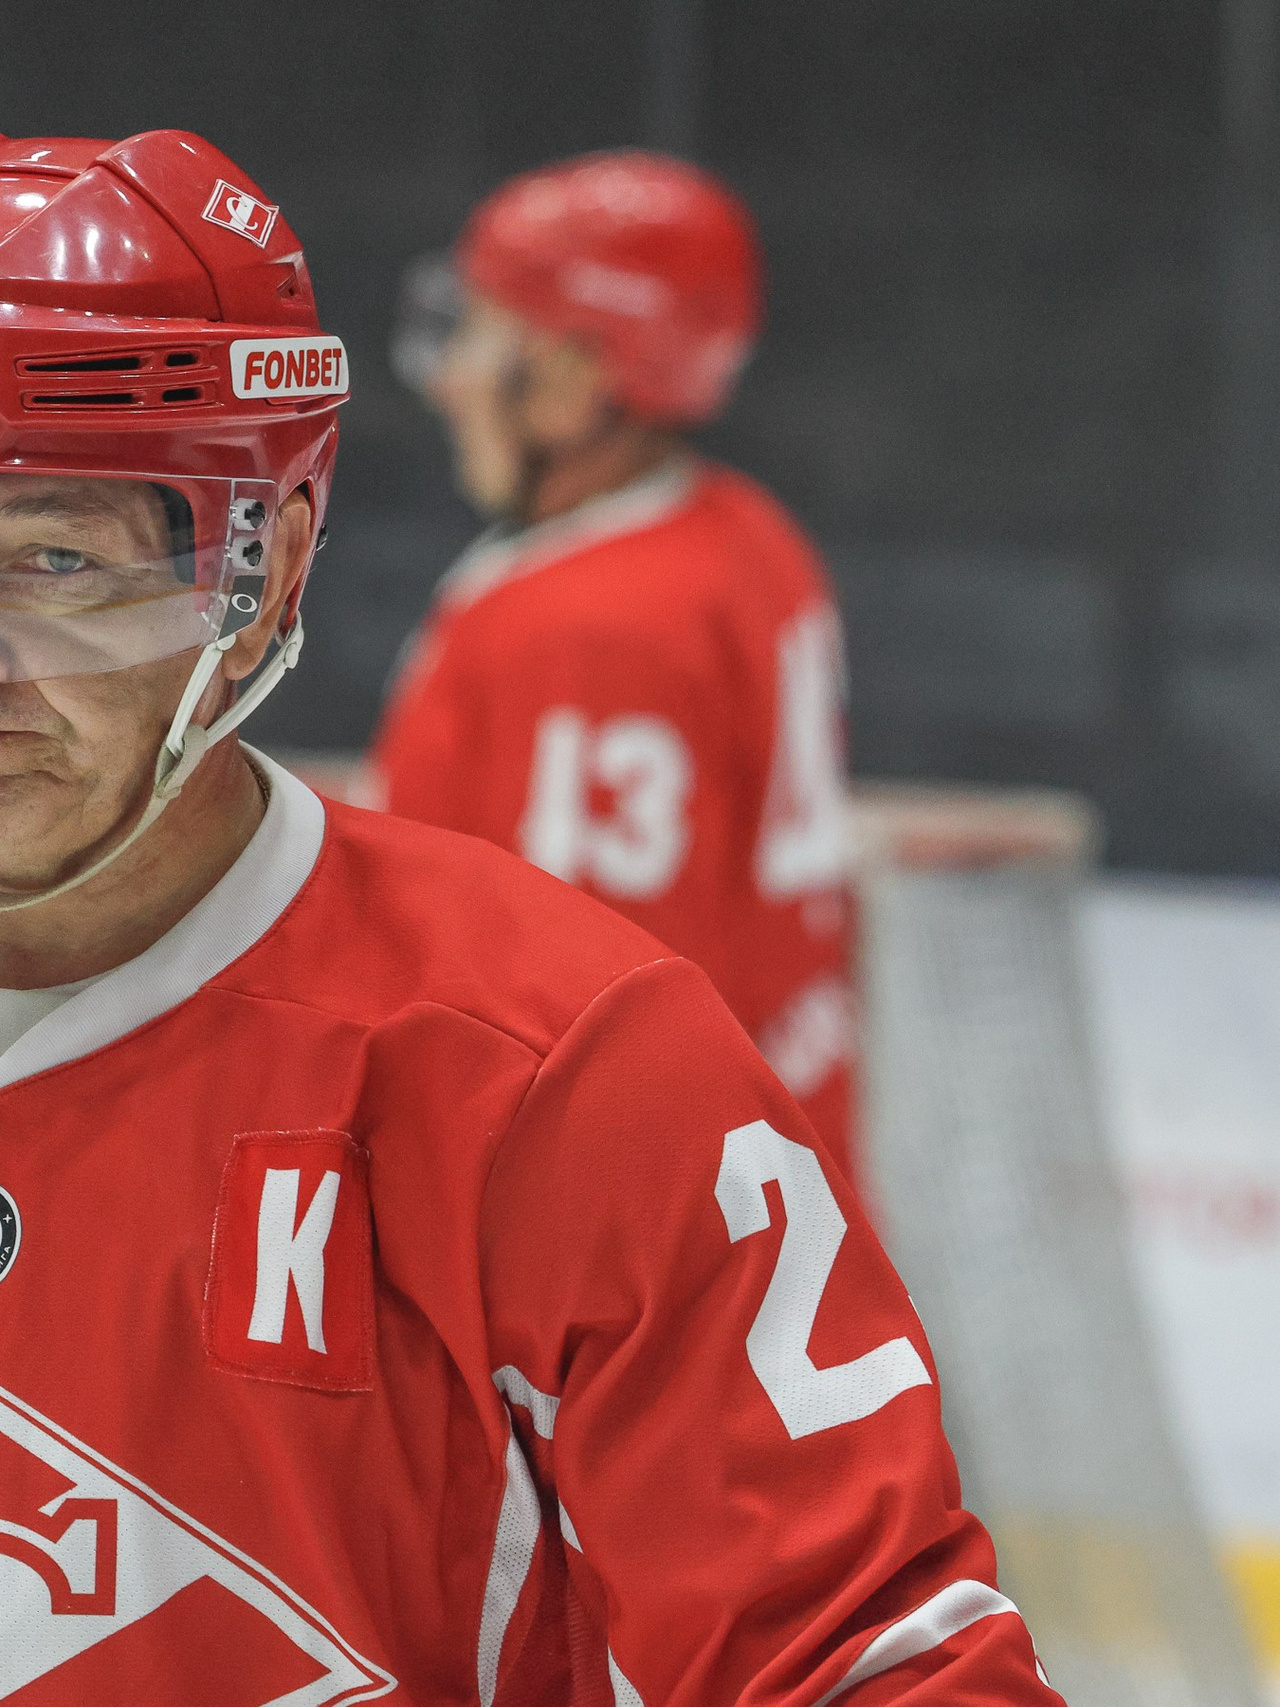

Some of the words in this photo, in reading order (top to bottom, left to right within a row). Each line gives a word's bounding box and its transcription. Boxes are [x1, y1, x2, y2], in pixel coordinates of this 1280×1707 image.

[244, 348, 342, 391] FONBET
[521, 707, 694, 898] 13
[247, 1167, 342, 1355] К
[713, 1118, 934, 1440] 2
